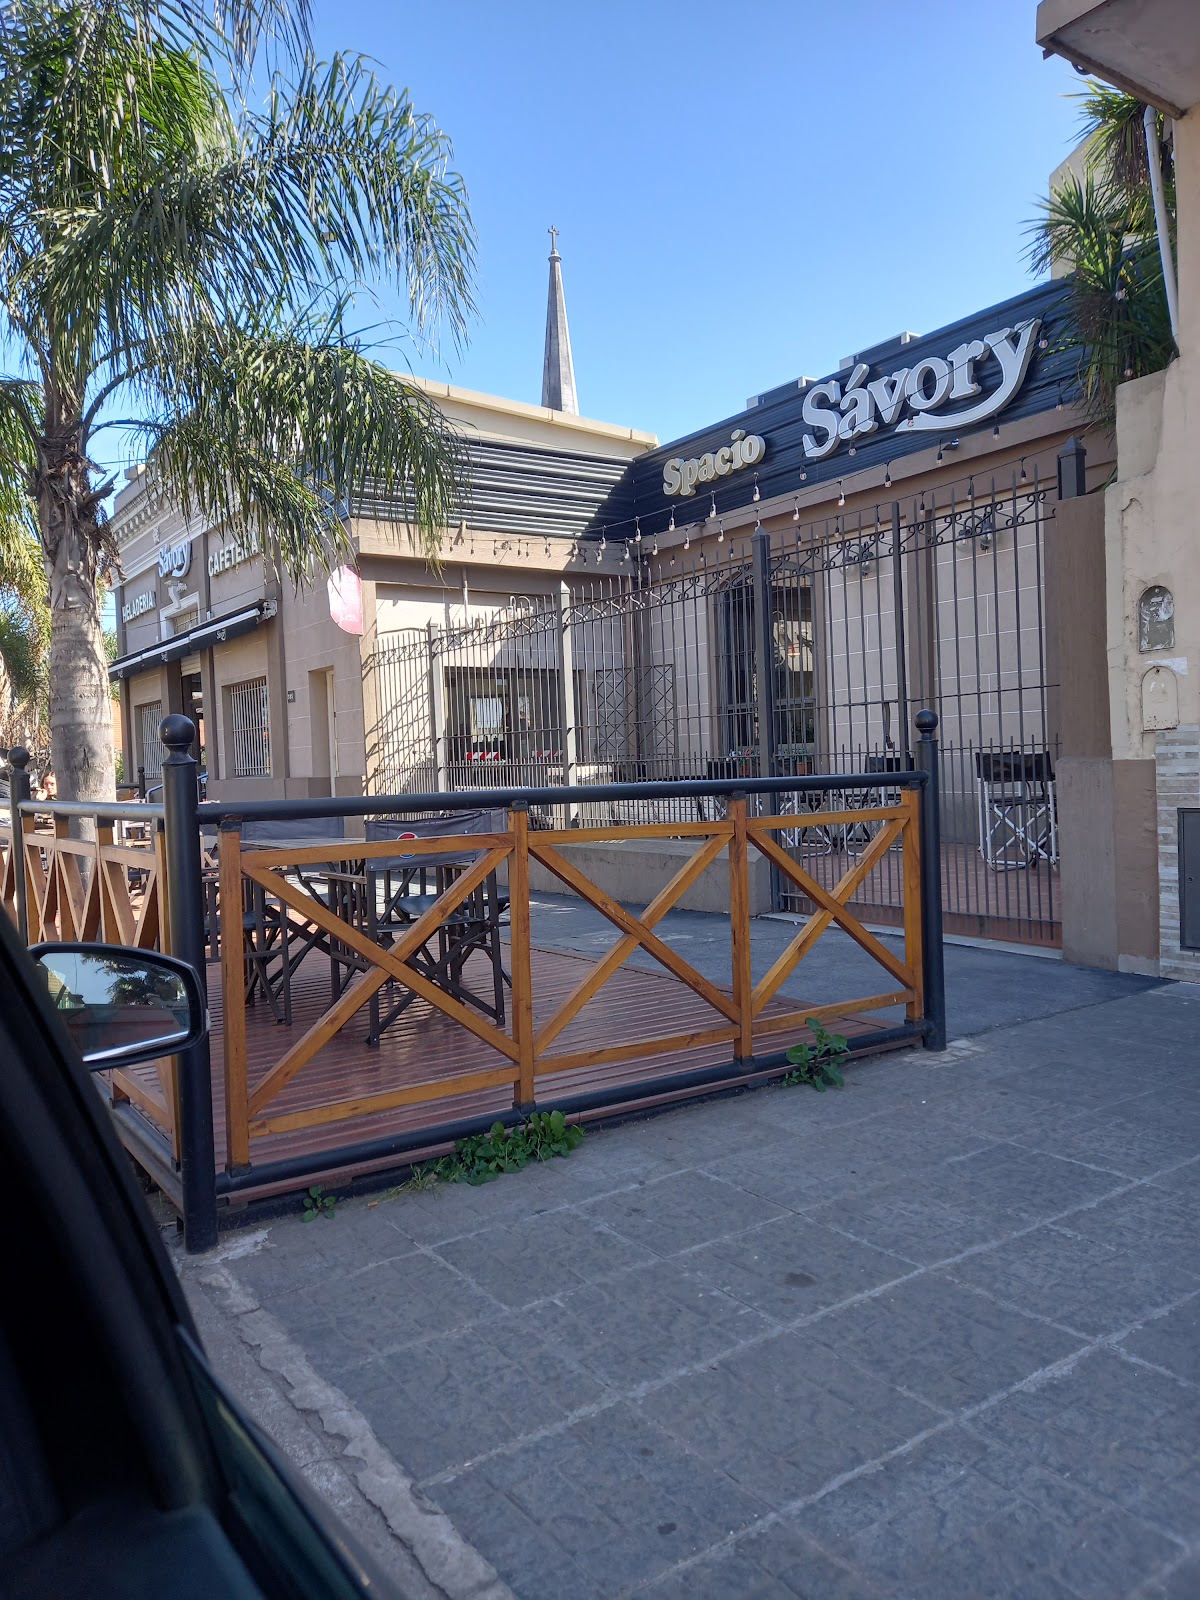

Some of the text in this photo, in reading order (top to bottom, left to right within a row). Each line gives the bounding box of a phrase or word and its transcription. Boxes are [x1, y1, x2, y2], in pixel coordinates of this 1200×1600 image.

[663, 317, 1042, 496] Spacio Sávory
[121, 590, 155, 624] HELADERIA
